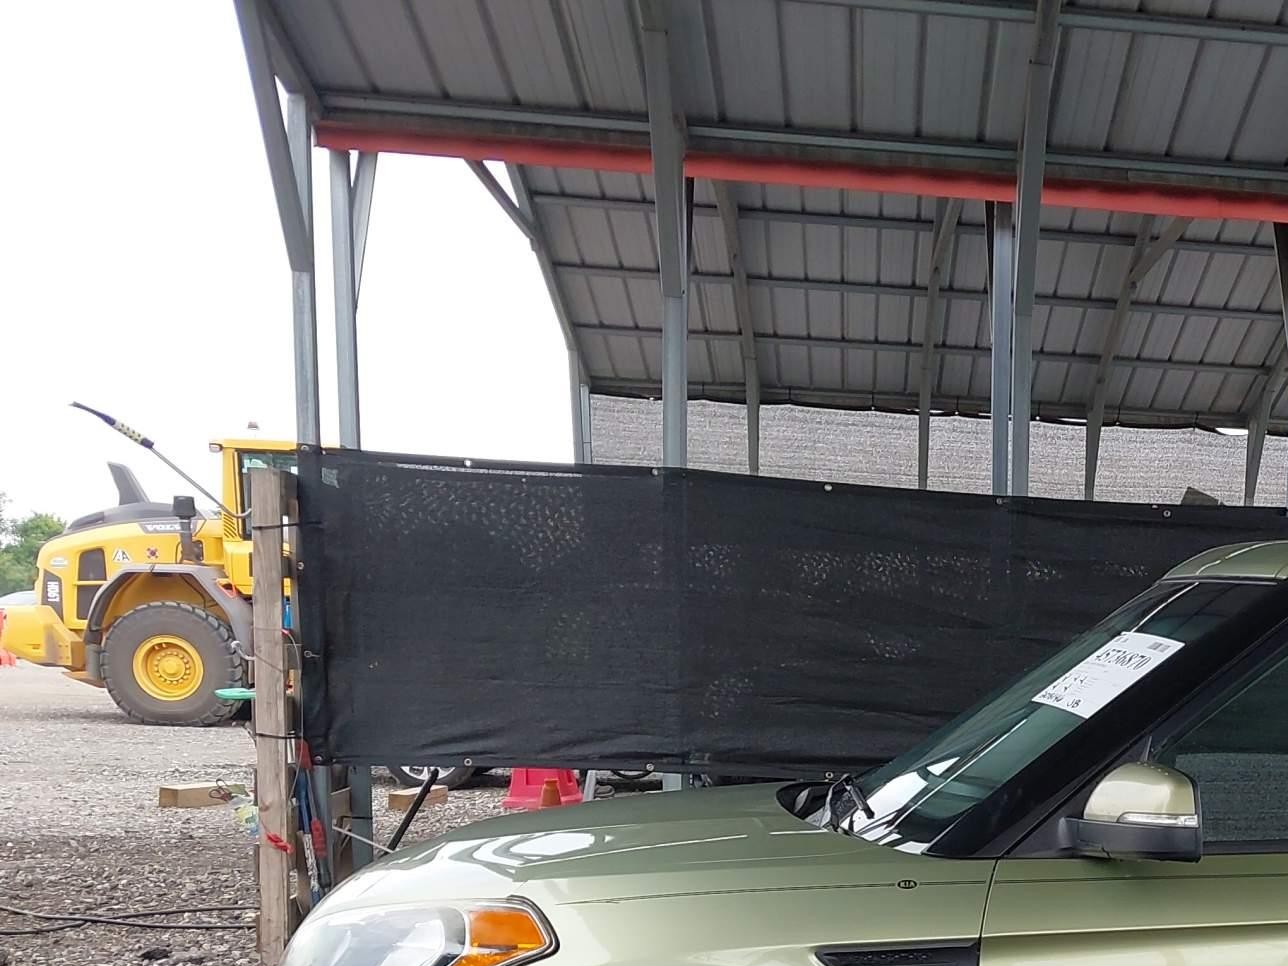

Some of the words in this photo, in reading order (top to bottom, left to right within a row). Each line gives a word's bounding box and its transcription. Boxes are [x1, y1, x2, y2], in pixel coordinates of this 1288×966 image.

[47, 581, 60, 602] L90H
[1095, 649, 1152, 670] 45736870
[900, 881, 915, 889] KIA
